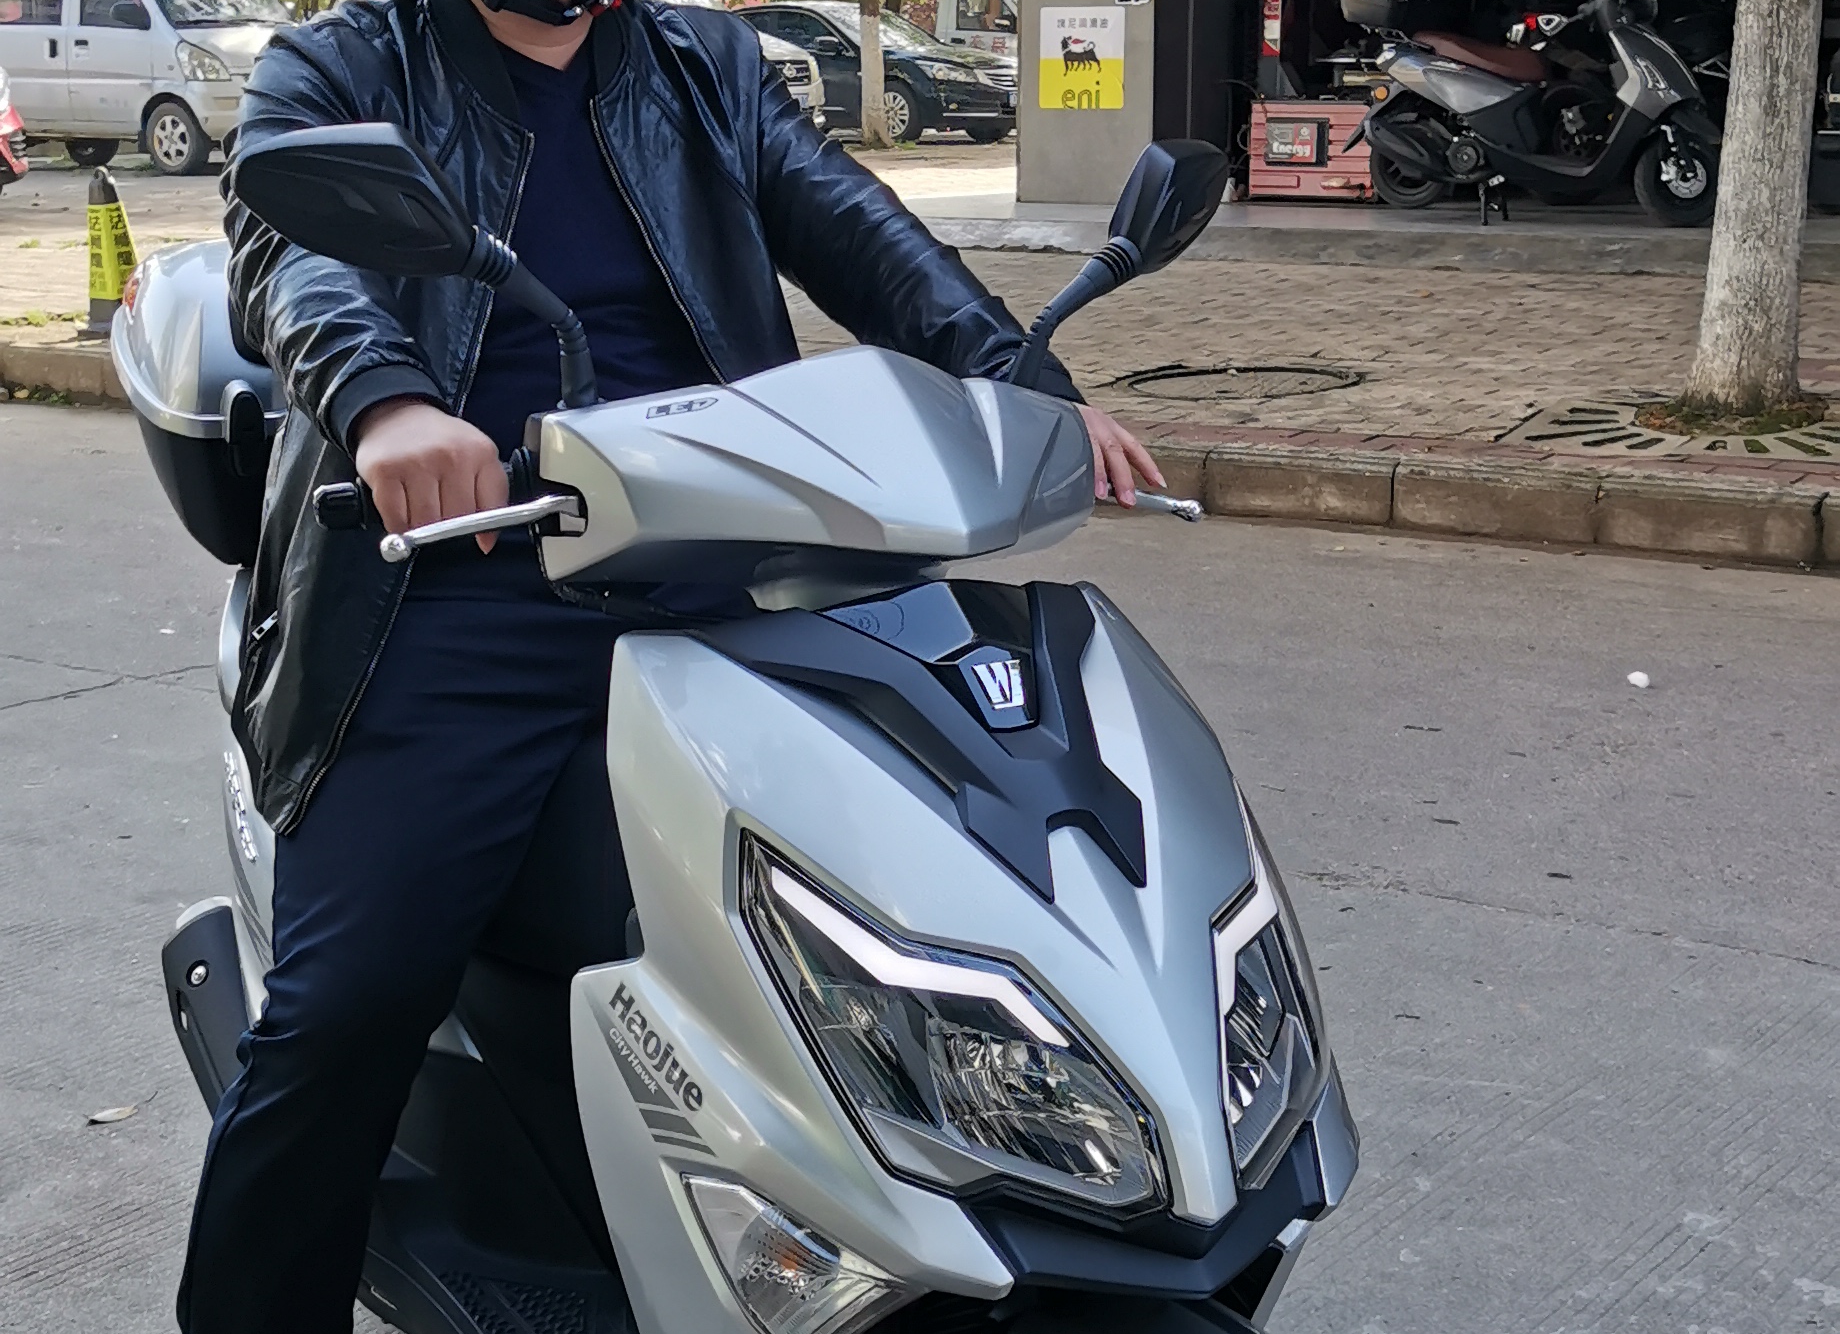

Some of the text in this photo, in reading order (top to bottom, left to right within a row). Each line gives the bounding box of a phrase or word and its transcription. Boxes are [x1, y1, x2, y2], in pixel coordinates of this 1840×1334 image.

[1061, 80, 1100, 109] eni
[646, 397, 719, 419] LED
[608, 980, 703, 1112] Haojue
